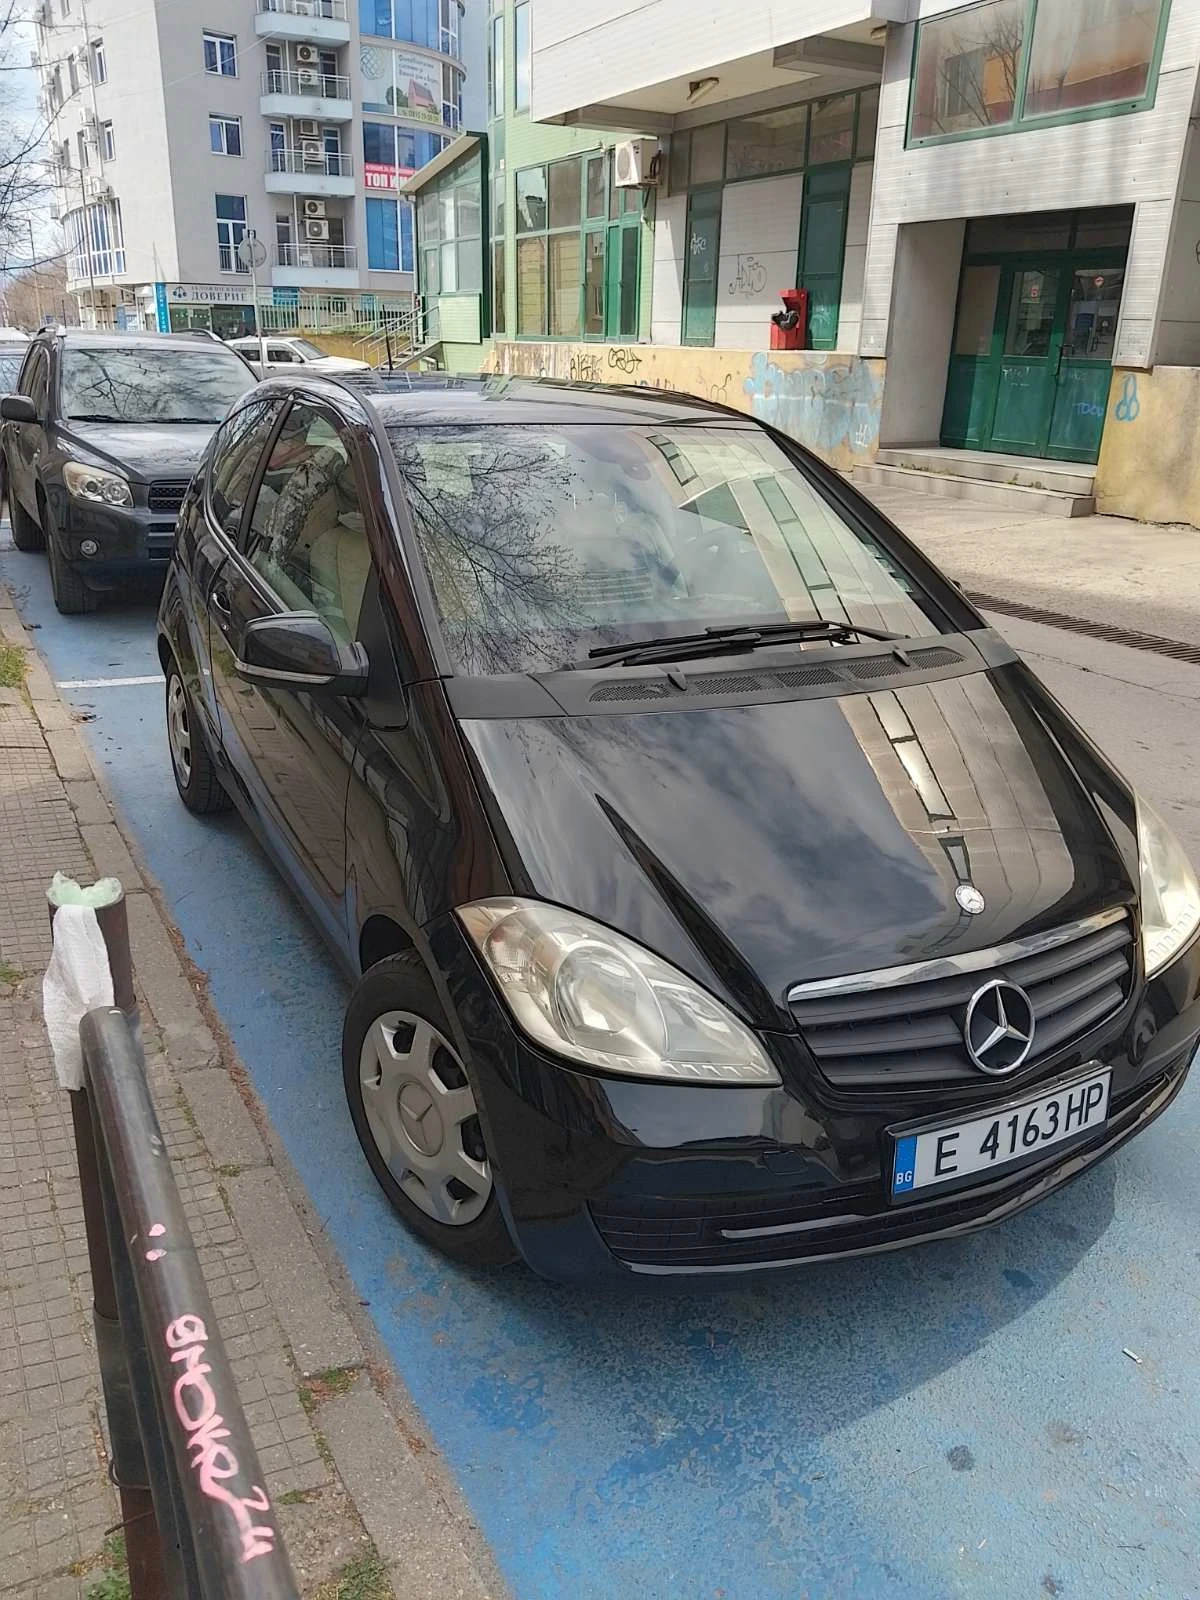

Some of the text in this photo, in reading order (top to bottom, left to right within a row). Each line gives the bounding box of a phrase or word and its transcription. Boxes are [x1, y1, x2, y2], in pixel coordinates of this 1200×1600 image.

[366, 172, 388, 187] ТОП
[191, 291, 247, 301] ДОВЕРИЕ
[934, 1082, 1104, 1177] E 4163 HP
[896, 1170, 912, 1185] BG
